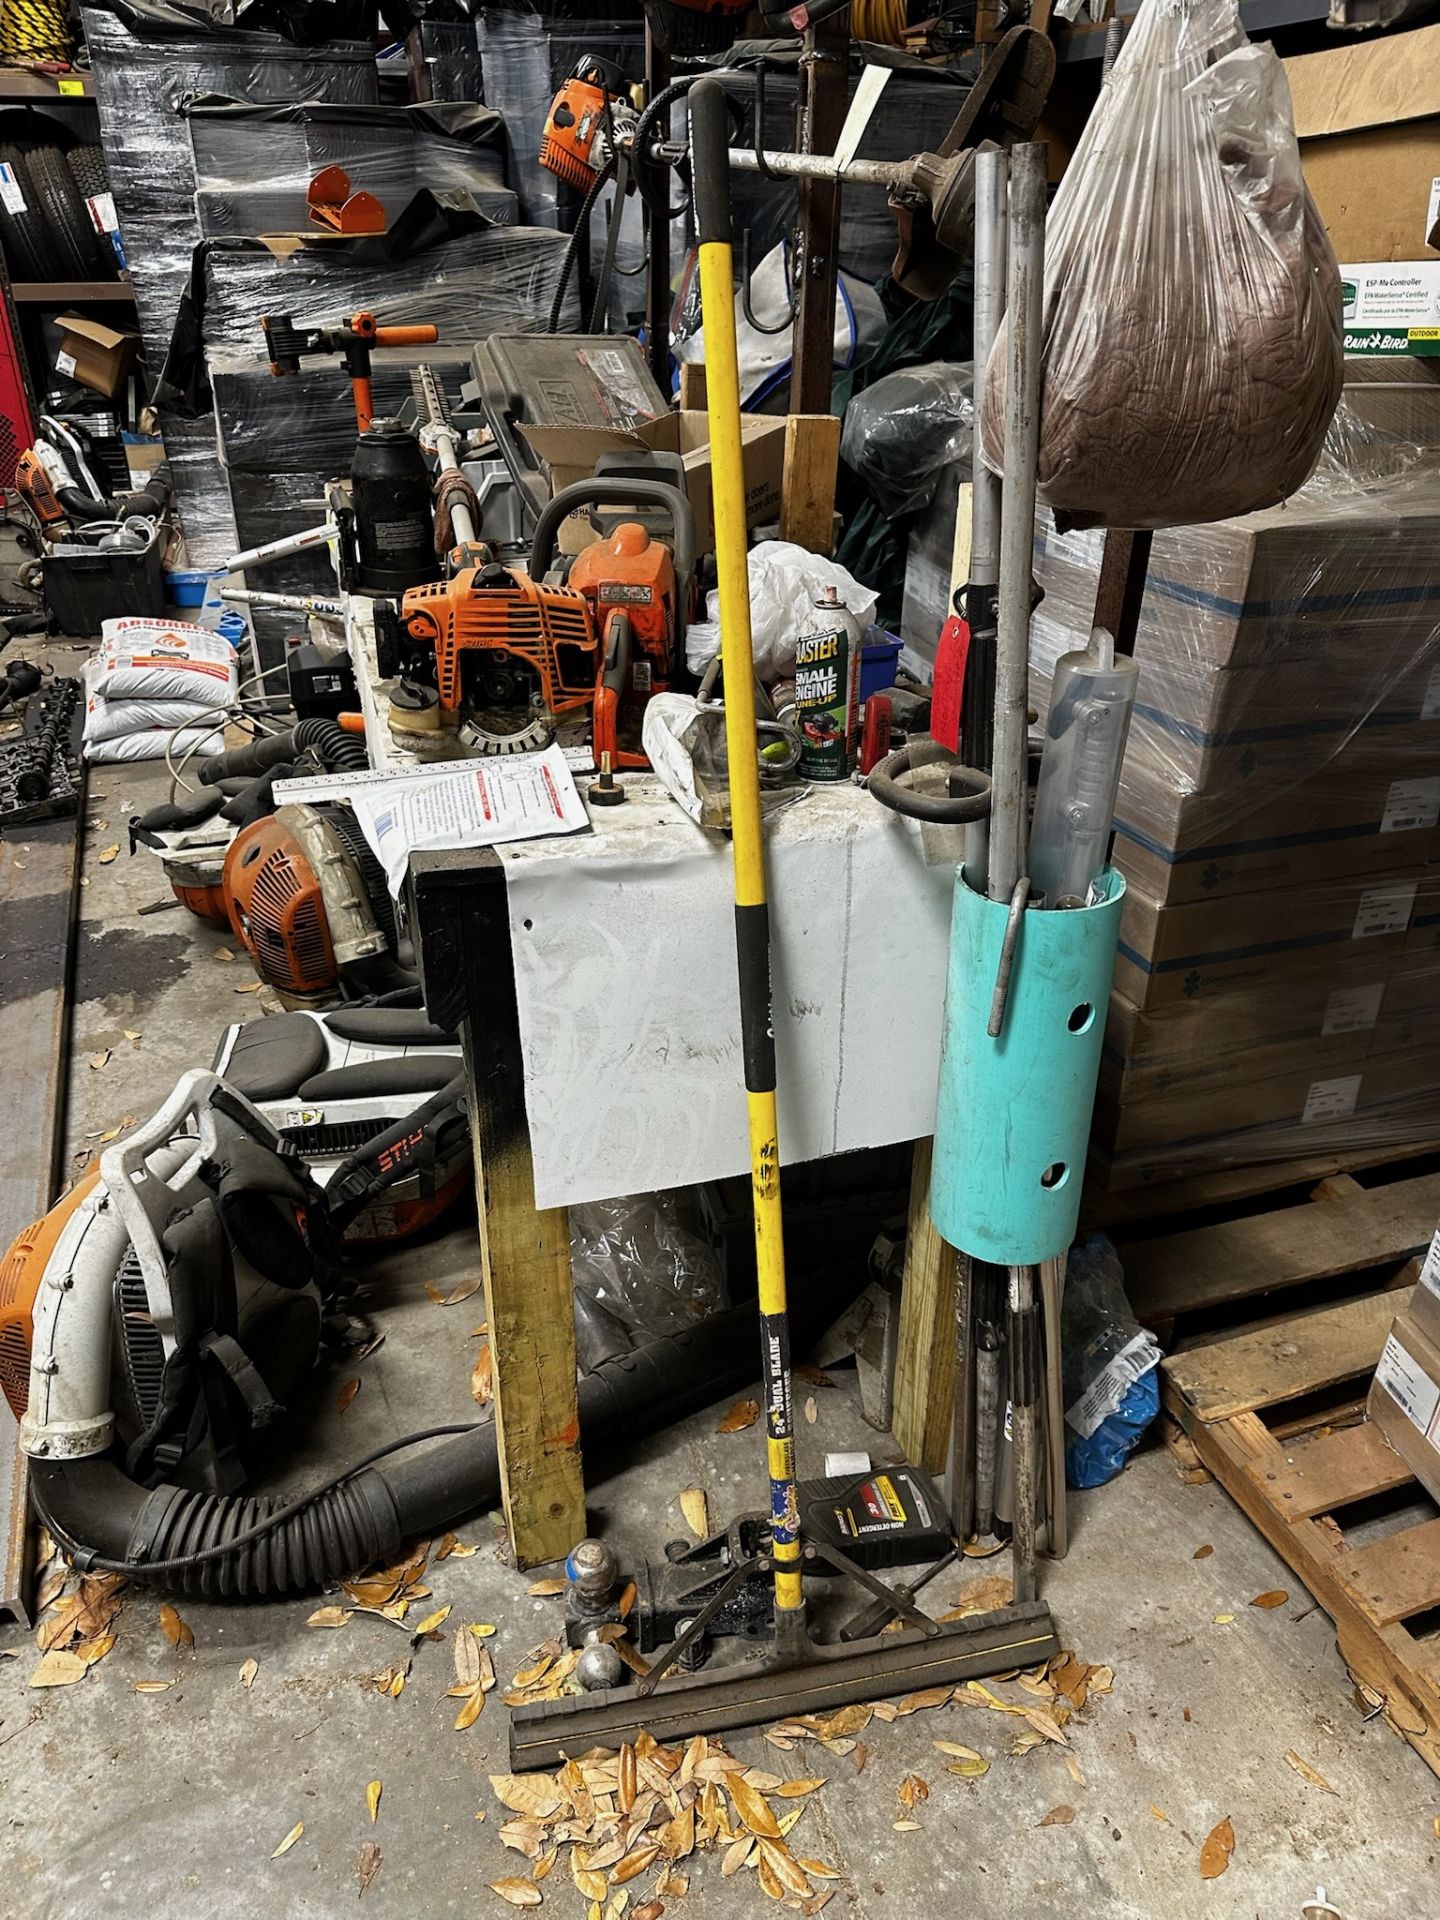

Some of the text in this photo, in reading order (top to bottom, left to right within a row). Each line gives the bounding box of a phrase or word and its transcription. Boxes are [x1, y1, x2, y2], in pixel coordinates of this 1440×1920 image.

[1389, 277, 1422, 286] Controller
[1405, 290, 1429, 298] Certified
[1409, 329, 1439, 337] OUTDOOR
[1379, 335, 1408, 349] BIRD
[796, 666, 838, 686] SMALL
[796, 678, 837, 700] ENGINE
[796, 693, 837, 708] UNE-UP
[769, 1336, 782, 1377] BLADE
[771, 1379, 785, 1413] DUAL
[867, 1502, 880, 1515] 30
[858, 1521, 905, 1534] NON-DETERGENT
